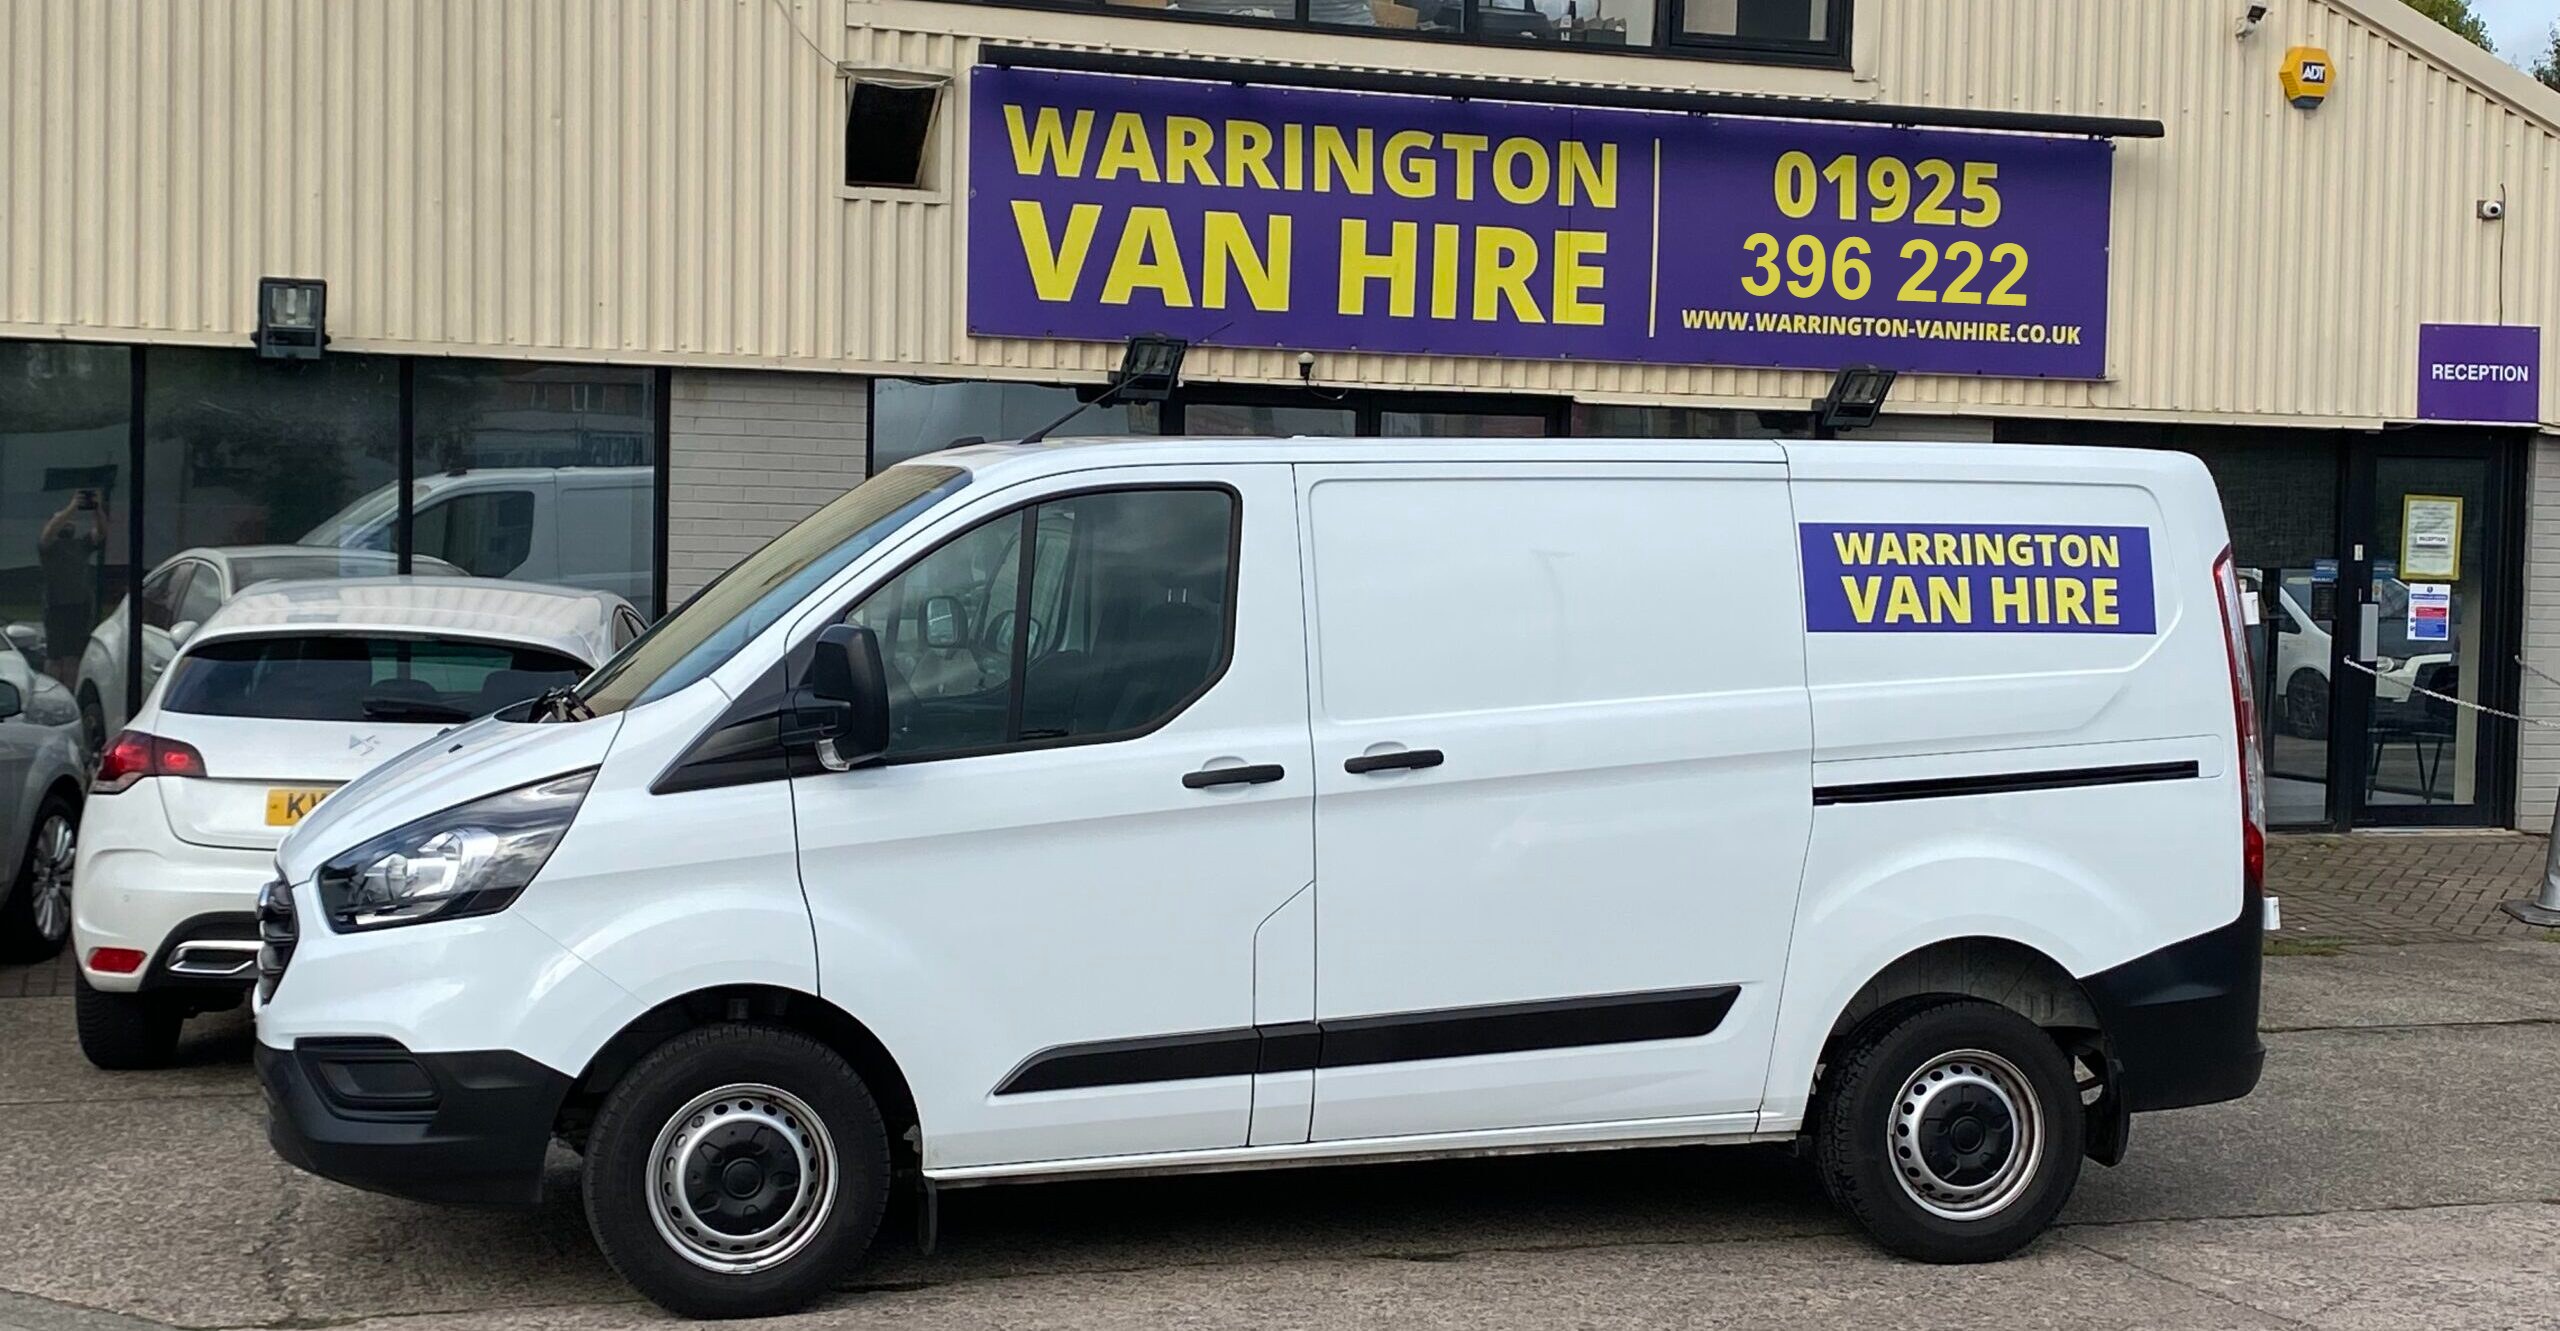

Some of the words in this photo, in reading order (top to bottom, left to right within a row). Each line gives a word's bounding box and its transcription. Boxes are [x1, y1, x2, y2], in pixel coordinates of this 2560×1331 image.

[2301, 65, 2326, 81] ADT
[1003, 104, 1617, 209] WARRINGTON
[1774, 151, 2002, 228] 01925
[1011, 200, 1292, 312] VAN
[1338, 218, 1608, 326] HIRE
[1741, 232, 1872, 301] 396
[1896, 238, 2029, 307] 222
[1681, 309, 2082, 345] WWW.WARRINGTON-VANHIRE.CO.UK
[2432, 364, 2529, 382] RECEPTION
[1832, 532, 2120, 568] WARRINGTON
[1840, 575, 1972, 624] VAN
[1991, 577, 2120, 625] HIRE
